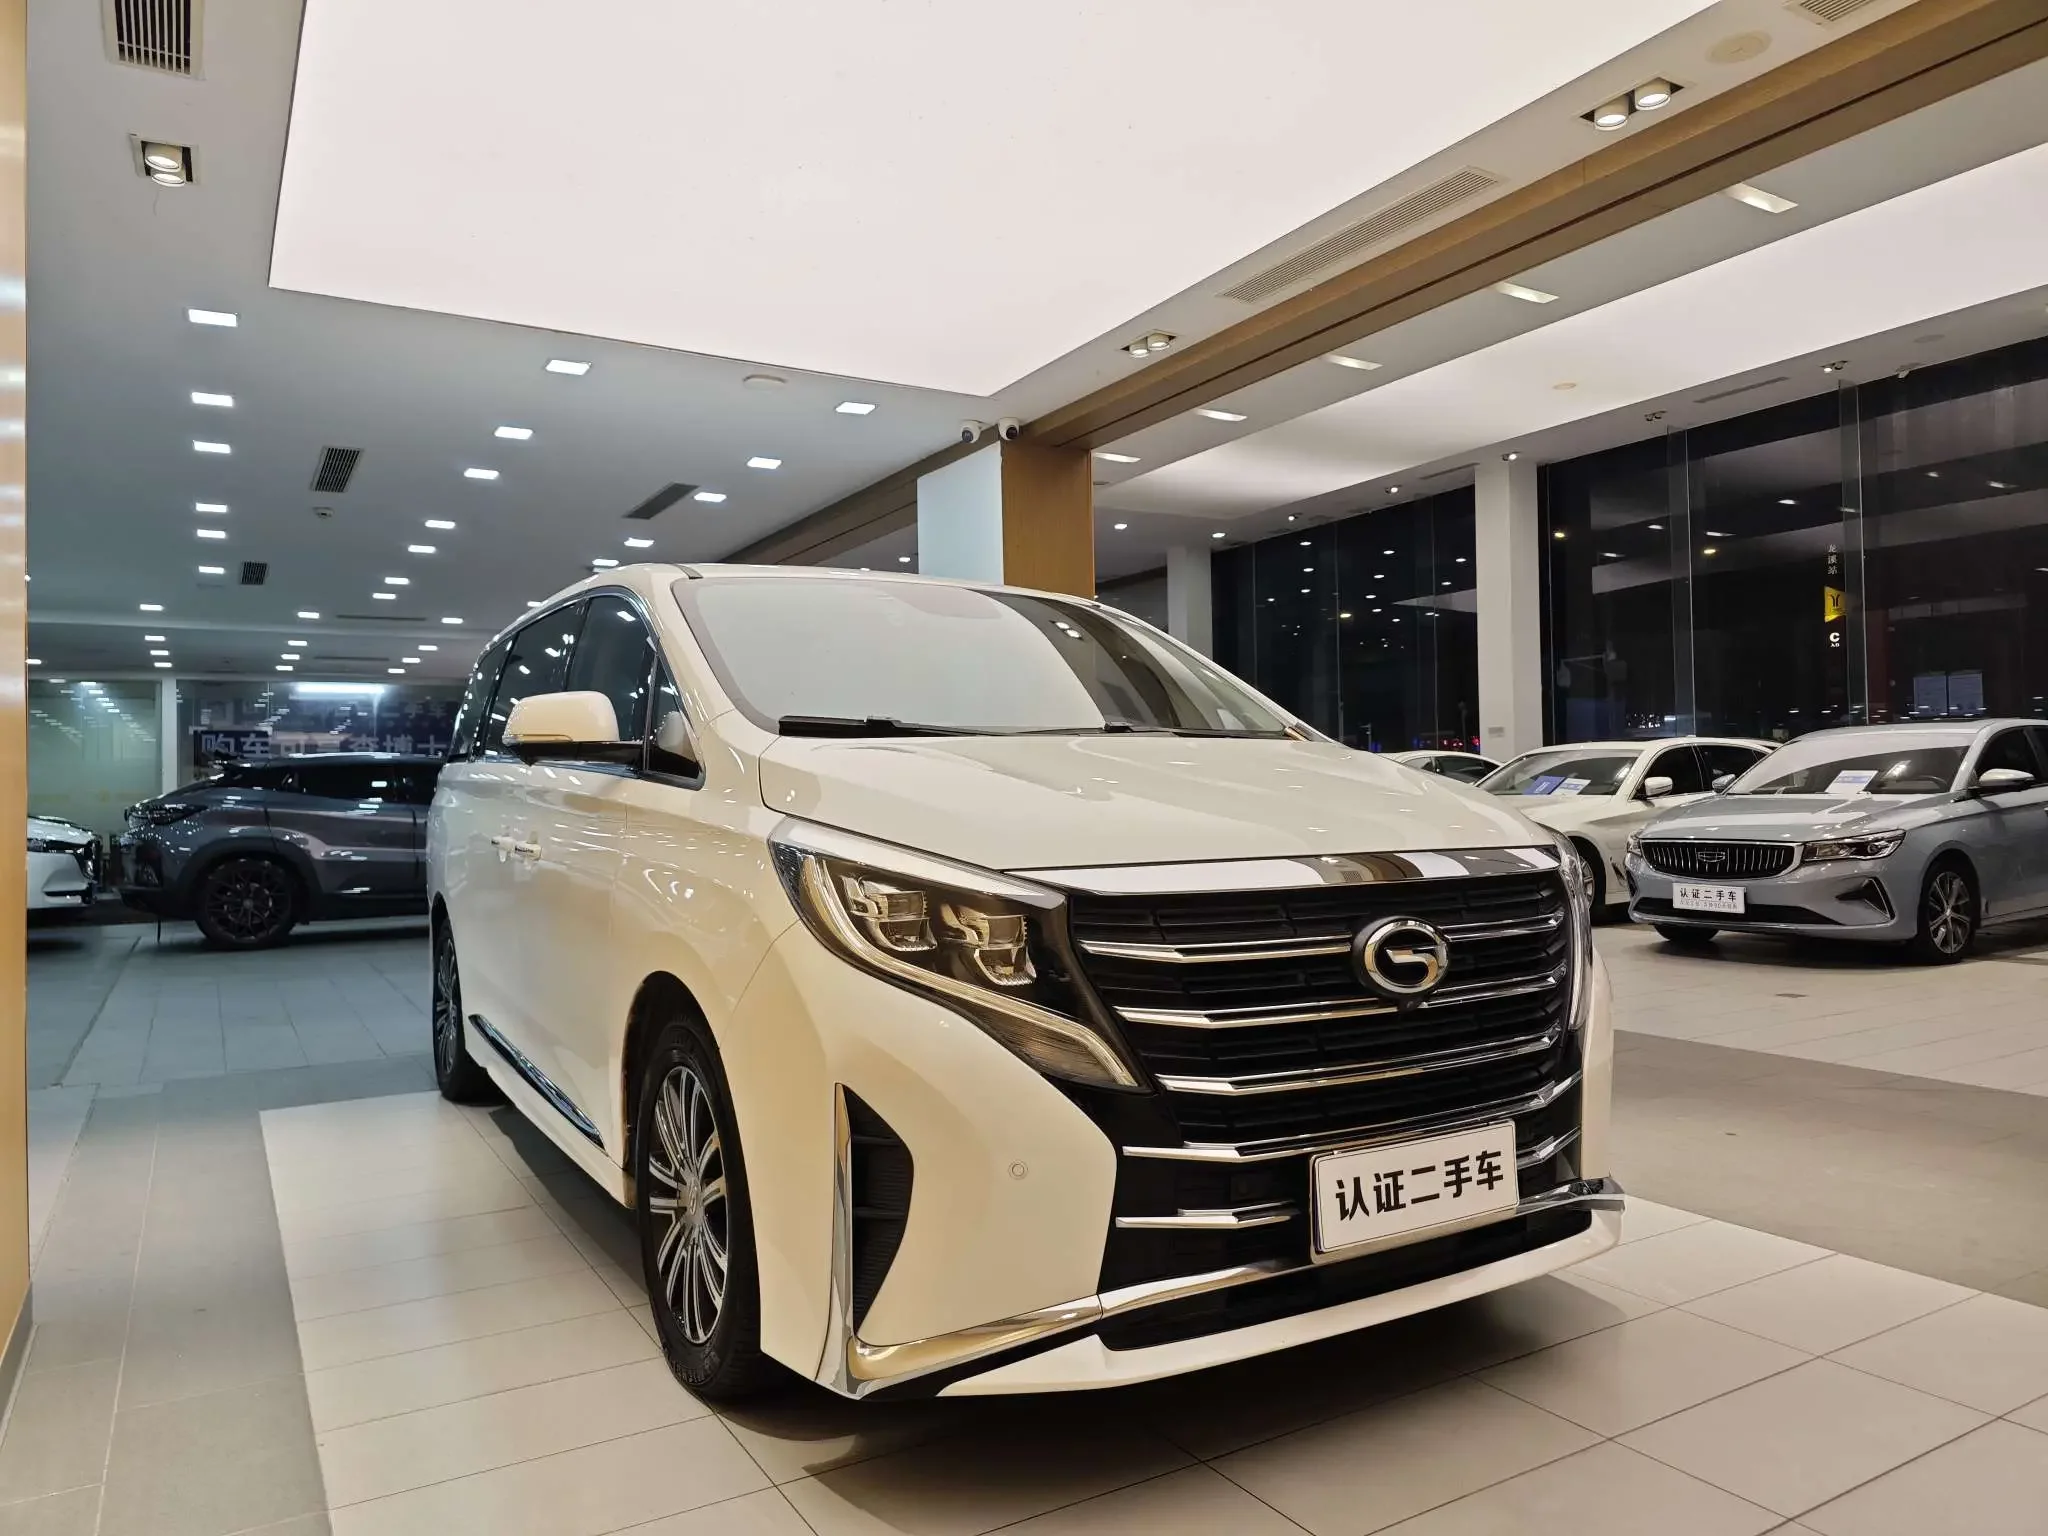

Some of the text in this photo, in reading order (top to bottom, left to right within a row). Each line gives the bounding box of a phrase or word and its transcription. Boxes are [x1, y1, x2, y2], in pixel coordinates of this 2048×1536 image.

[1829, 632, 1840, 643] C
[1680, 888, 1737, 902] 认证二手车
[1335, 1150, 1504, 1221] 认证二手车
